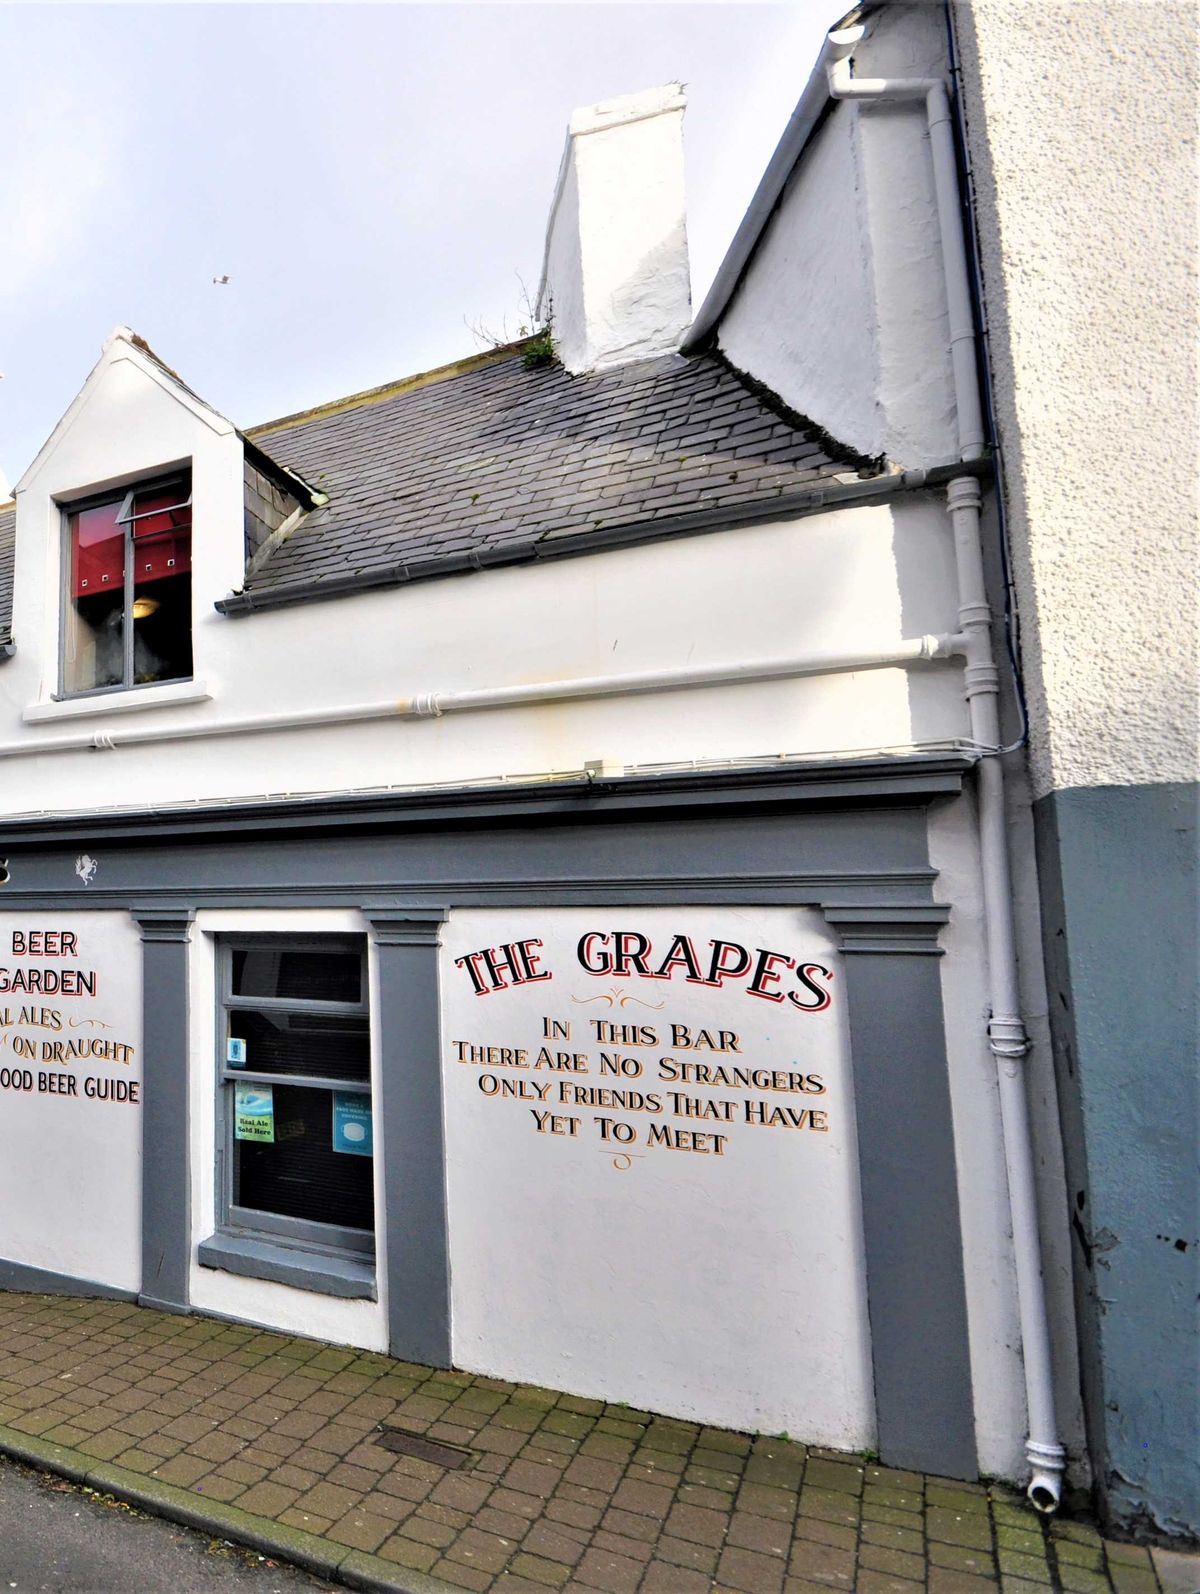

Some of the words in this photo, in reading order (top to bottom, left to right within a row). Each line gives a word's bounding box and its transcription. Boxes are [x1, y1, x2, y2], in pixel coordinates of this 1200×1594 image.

[12, 931, 78, 956] BEER
[454, 938, 552, 996] THE
[576, 931, 833, 1012] GRAPES
[18, 1006, 63, 1031] ALES
[542, 1016, 571, 1040] IN
[590, 1019, 658, 1047] THIS
[670, 1024, 743, 1053] BAR
[13, 1035, 37, 1060] ON
[42, 1038, 135, 1065] DRAUGHT
[452, 1040, 530, 1068] THERE
[534, 1047, 588, 1073] ARE
[599, 1052, 644, 1078] NO
[658, 1056, 828, 1095] STRANGERS
[38, 1072, 79, 1097] BEER
[84, 1077, 141, 1104] GUIDE
[478, 1073, 551, 1101] ONLY
[559, 1081, 663, 1114] FRIENDS
[666, 1091, 738, 1123] THAT
[744, 1100, 829, 1132] HAVE
[238, 1126, 253, 1134] Sold
[254, 1127, 271, 1136] Here
[256, 1119, 269, 1127] Ale
[530, 1109, 581, 1137] YET
[594, 1116, 637, 1144] TO
[647, 1123, 728, 1156] MEET
